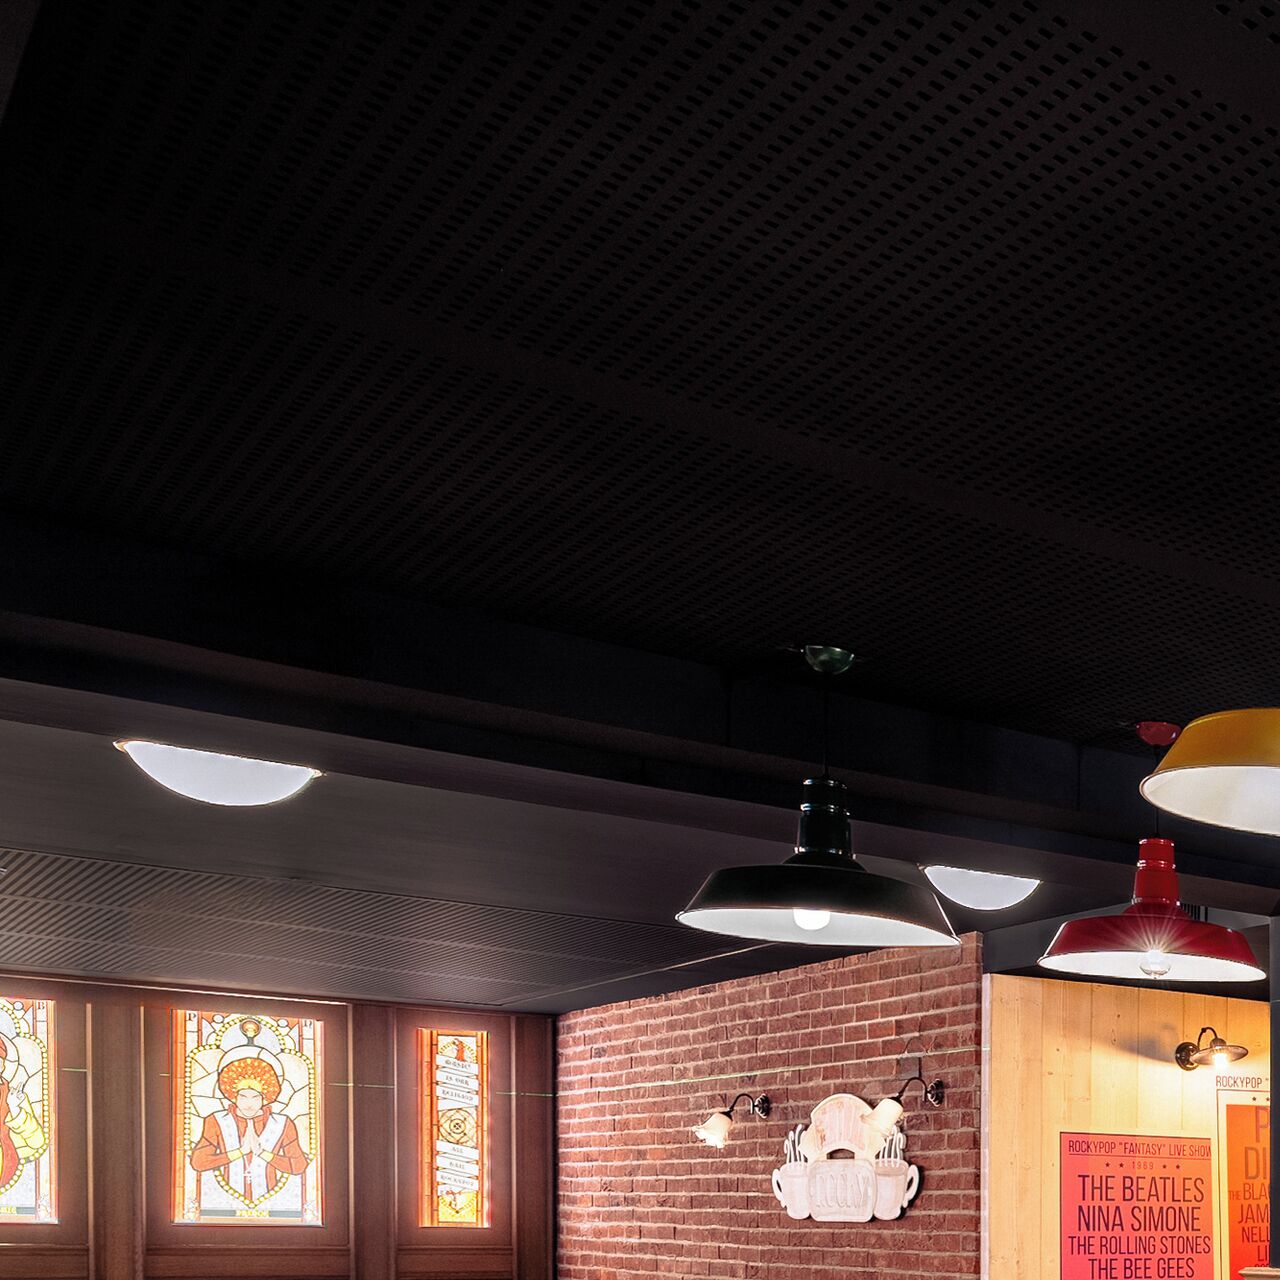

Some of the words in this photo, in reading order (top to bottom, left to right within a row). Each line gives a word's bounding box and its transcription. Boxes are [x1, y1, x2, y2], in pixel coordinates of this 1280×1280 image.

[1215, 1075, 1263, 1089] ROCKYPOP
[1068, 1140, 1116, 1154] ROCKYPOP
[1119, 1142, 1166, 1156] "FANTASY"
[1169, 1143, 1187, 1157] LIVE
[1188, 1145, 1211, 1157] SHOW
[1078, 1174, 1115, 1202] THE
[1122, 1175, 1204, 1203] BEATLES
[1243, 1182, 1271, 1200] BLA
[1078, 1205, 1124, 1232] NINA
[1130, 1206, 1201, 1232] SIMONE
[1068, 1236, 1095, 1255] THE
[1100, 1236, 1156, 1255] ROLLING
[1160, 1236, 1211, 1254] STONES
[1088, 1258, 1118, 1280] THE
[1123, 1258, 1152, 1279] BEE
[1157, 1257, 1195, 1279] GEES
